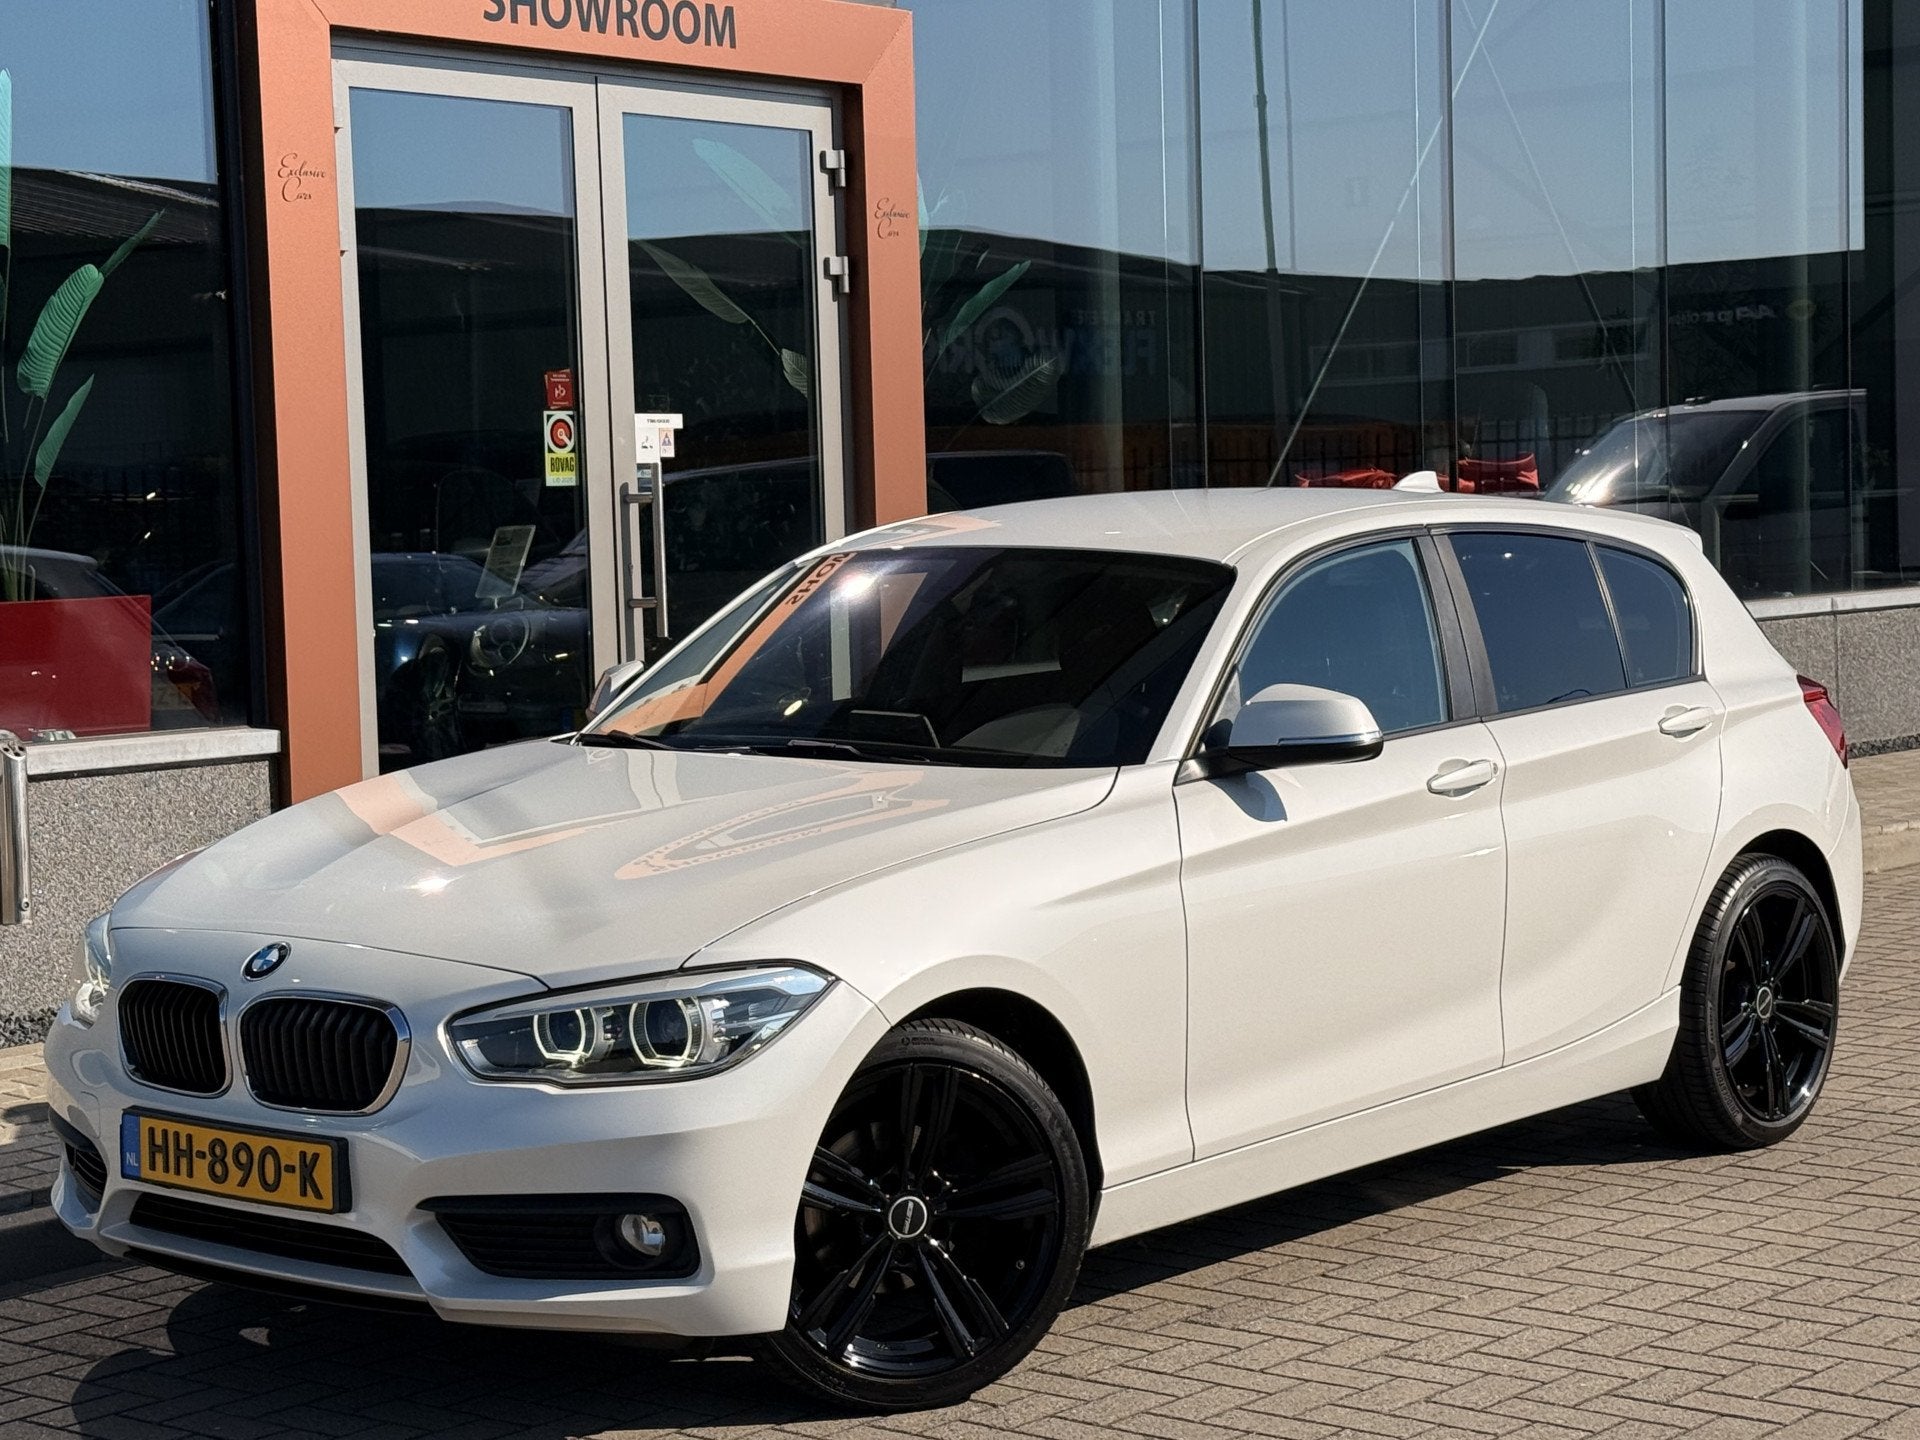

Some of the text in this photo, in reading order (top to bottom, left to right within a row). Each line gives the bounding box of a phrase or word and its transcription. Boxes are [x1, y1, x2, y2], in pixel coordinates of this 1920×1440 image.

[281, 176, 312, 203] Cars
[550, 456, 575, 472] BOVAG
[125, 1153, 139, 1167] NL
[147, 1126, 324, 1201] HH-890-K
